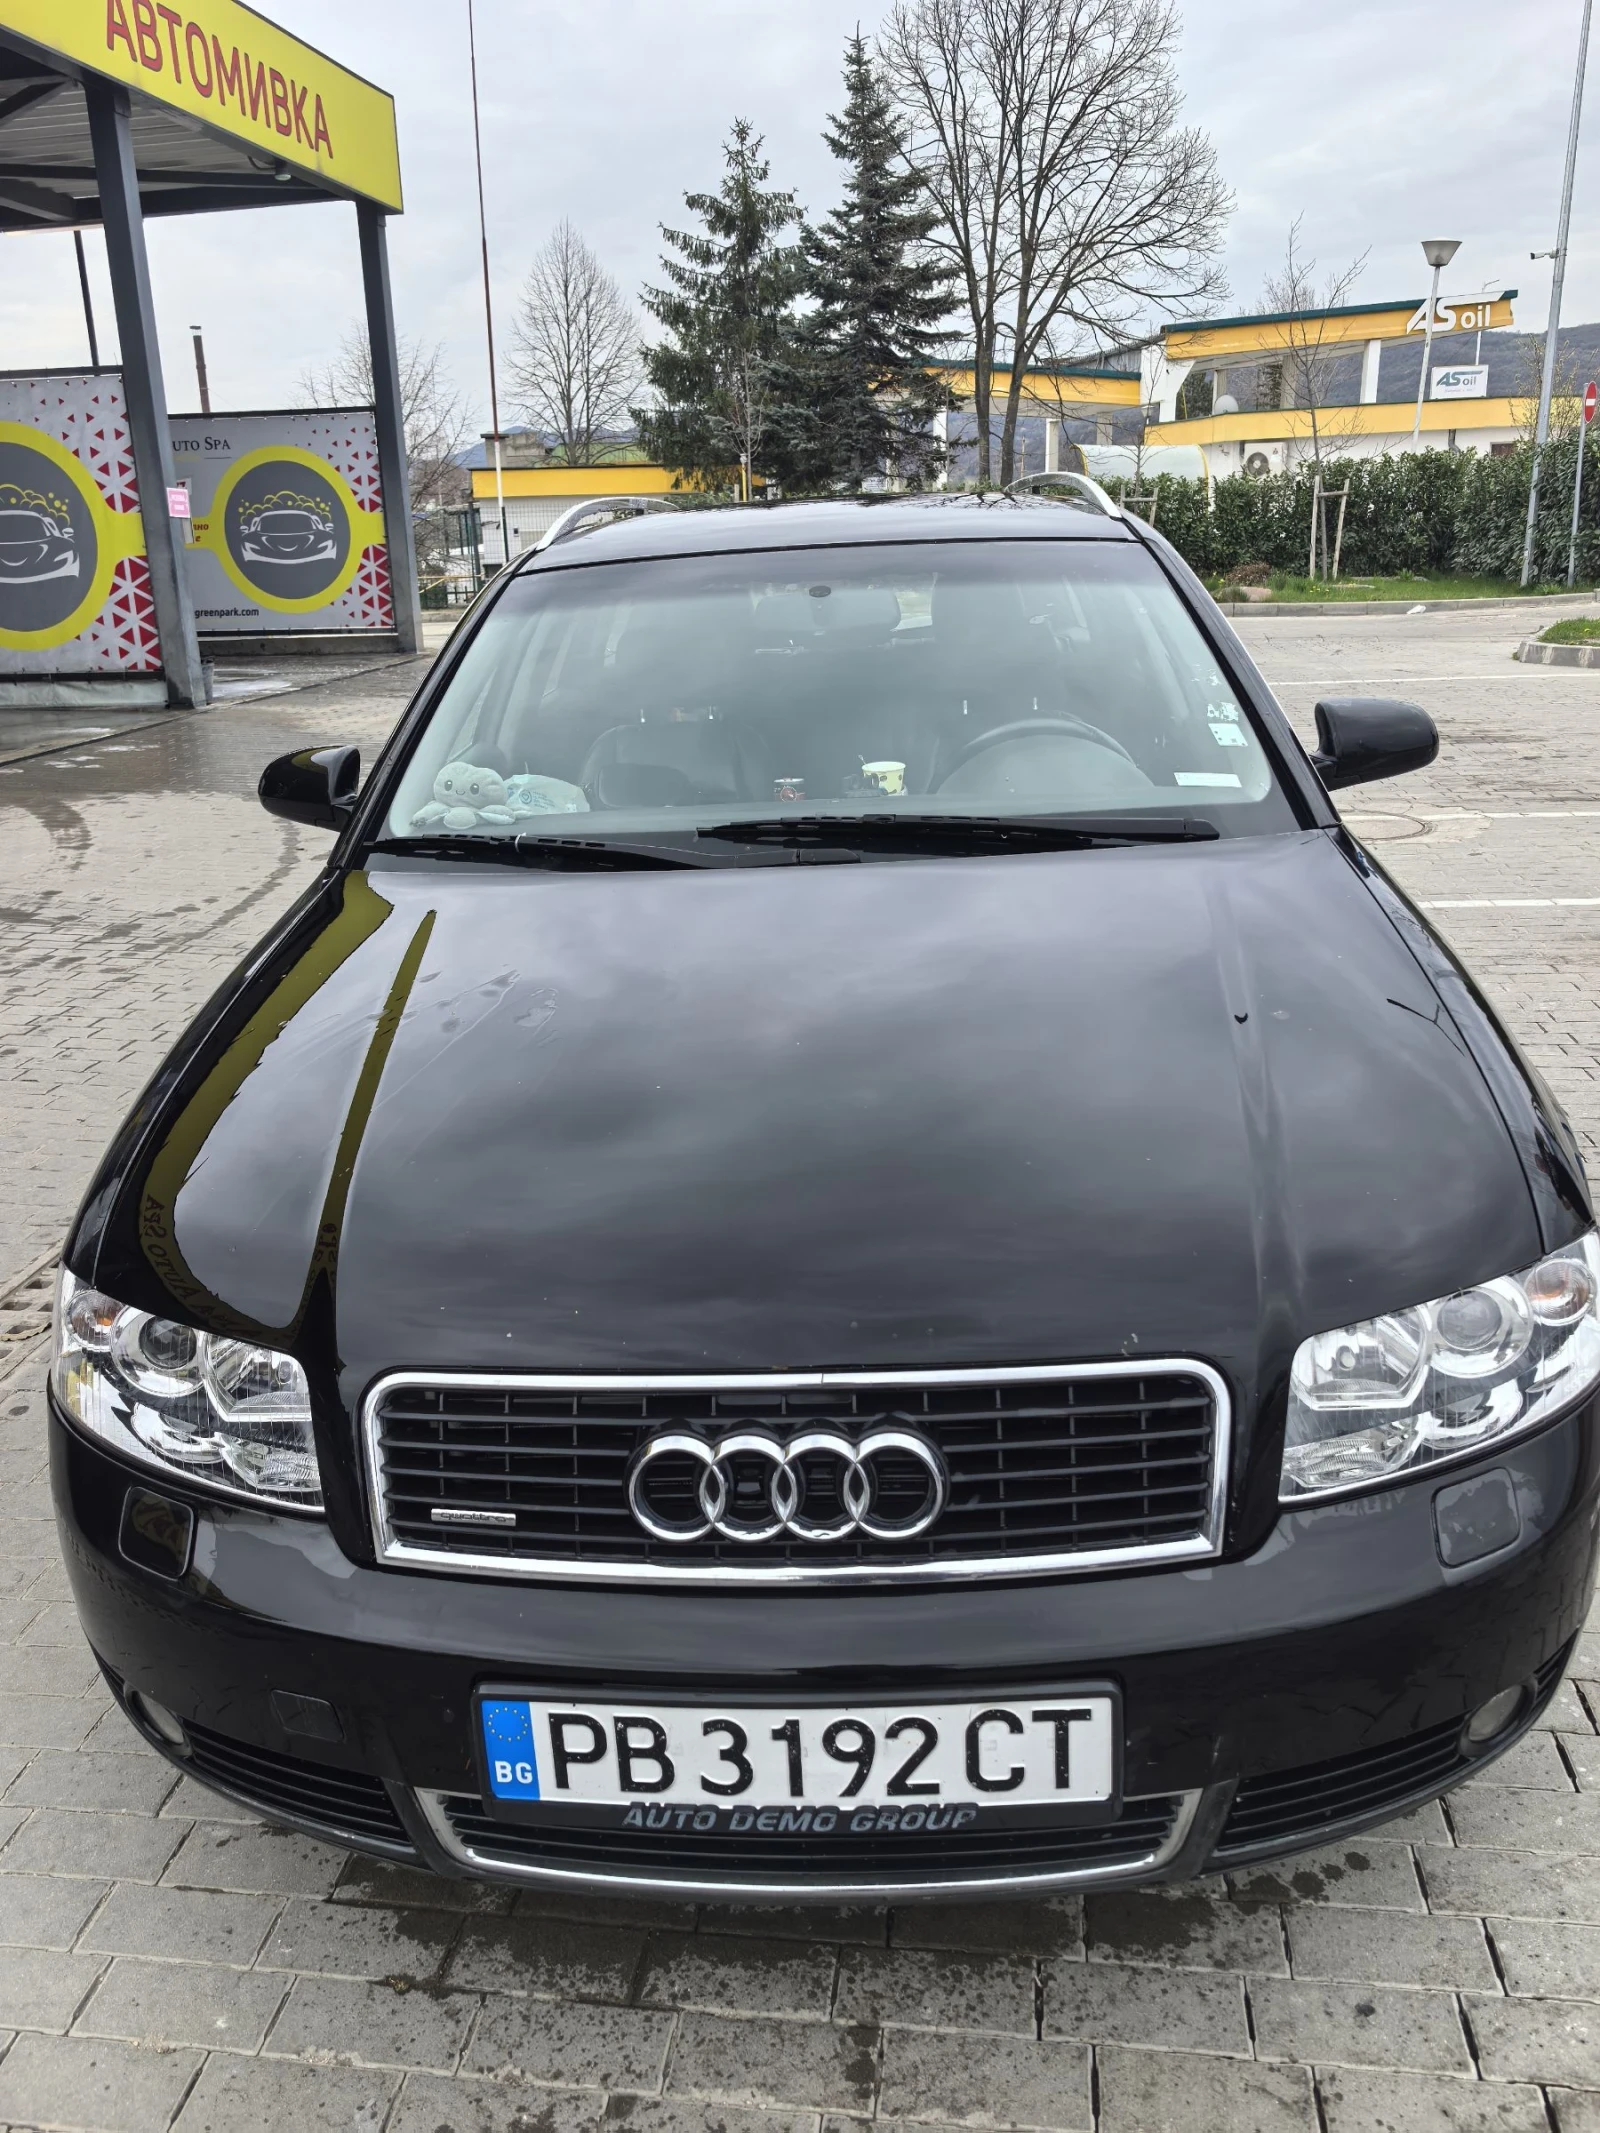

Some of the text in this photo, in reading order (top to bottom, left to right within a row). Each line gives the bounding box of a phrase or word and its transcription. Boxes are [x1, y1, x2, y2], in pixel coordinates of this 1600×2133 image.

[107, 0, 334, 160] АВТОМИВКА
[1461, 304, 1491, 329] oil
[1436, 370, 1484, 387] AS oil
[172, 440, 200, 451] UTO
[194, 607, 259, 619] greenpark.com
[439, 1511, 508, 1523] quattro
[547, 1708, 1092, 1798] PB 3192 CT
[495, 1761, 533, 1785] BG
[622, 1803, 978, 1834] AUTO DEMO GROUP
